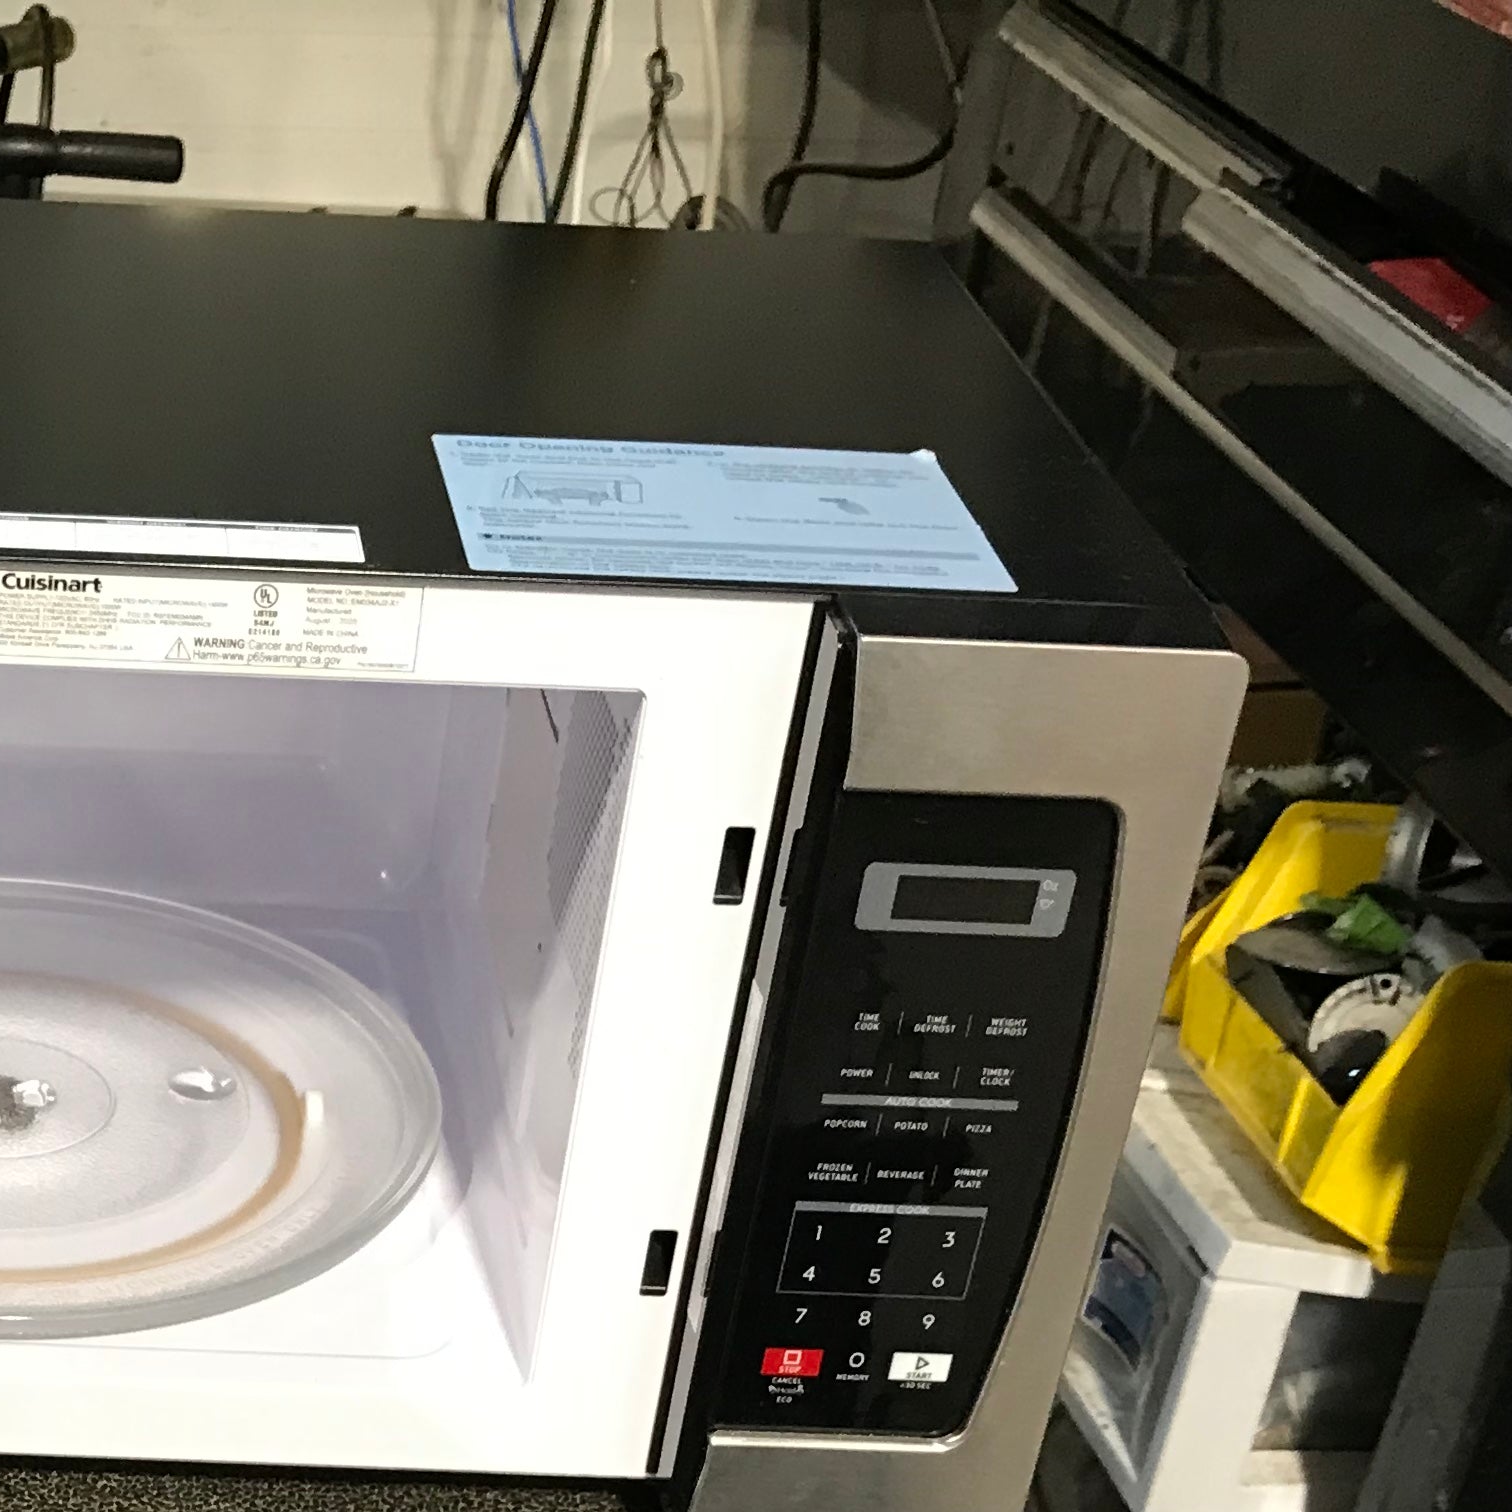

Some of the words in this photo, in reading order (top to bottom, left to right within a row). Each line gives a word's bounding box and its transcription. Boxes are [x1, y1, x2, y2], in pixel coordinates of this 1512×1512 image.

[2, 573, 101, 594] Cuisinart
[248, 639, 282, 651] Cancer
[285, 641, 303, 652] and
[305, 642, 368, 654] Reproductive
[859, 1012, 880, 1022] TIME
[926, 1014, 949, 1024] TIME
[991, 1017, 1027, 1027] WEIGHT
[854, 1022, 880, 1031] COOK
[913, 1024, 957, 1034] DEFROST
[985, 1027, 1028, 1037] DEFROST
[840, 1068, 874, 1078] POWER
[980, 1076, 1011, 1086] CLOCK
[884, 1096, 917, 1107] AUTO
[918, 1097, 953, 1108] COOK
[823, 1119, 868, 1129] POPCORN
[894, 1121, 929, 1131] POTATO
[965, 1124, 992, 1133] PIZZA
[817, 1162, 854, 1172] FROZEN
[807, 1172, 859, 1182] VEGETABLE
[876, 1169, 926, 1180] BEVERAGE
[954, 1168, 989, 1178] DINNER
[954, 1180, 982, 1189] PLATE
[816, 1225, 823, 1241] 1
[877, 1227, 892, 1244] 2
[942, 1231, 956, 1248] 3
[802, 1265, 816, 1282] 4
[868, 1268, 882, 1284] 5
[932, 1271, 945, 1288] 6
[795, 1308, 808, 1324] 7
[858, 1310, 872, 1326] 8
[922, 1314, 936, 1330] 9
[849, 1352, 865, 1368] 0
[836, 1373, 870, 1381] MEMORY
[906, 1371, 933, 1379] START
[771, 1376, 801, 1385] CANCEL
[775, 1396, 793, 1404] ECO
